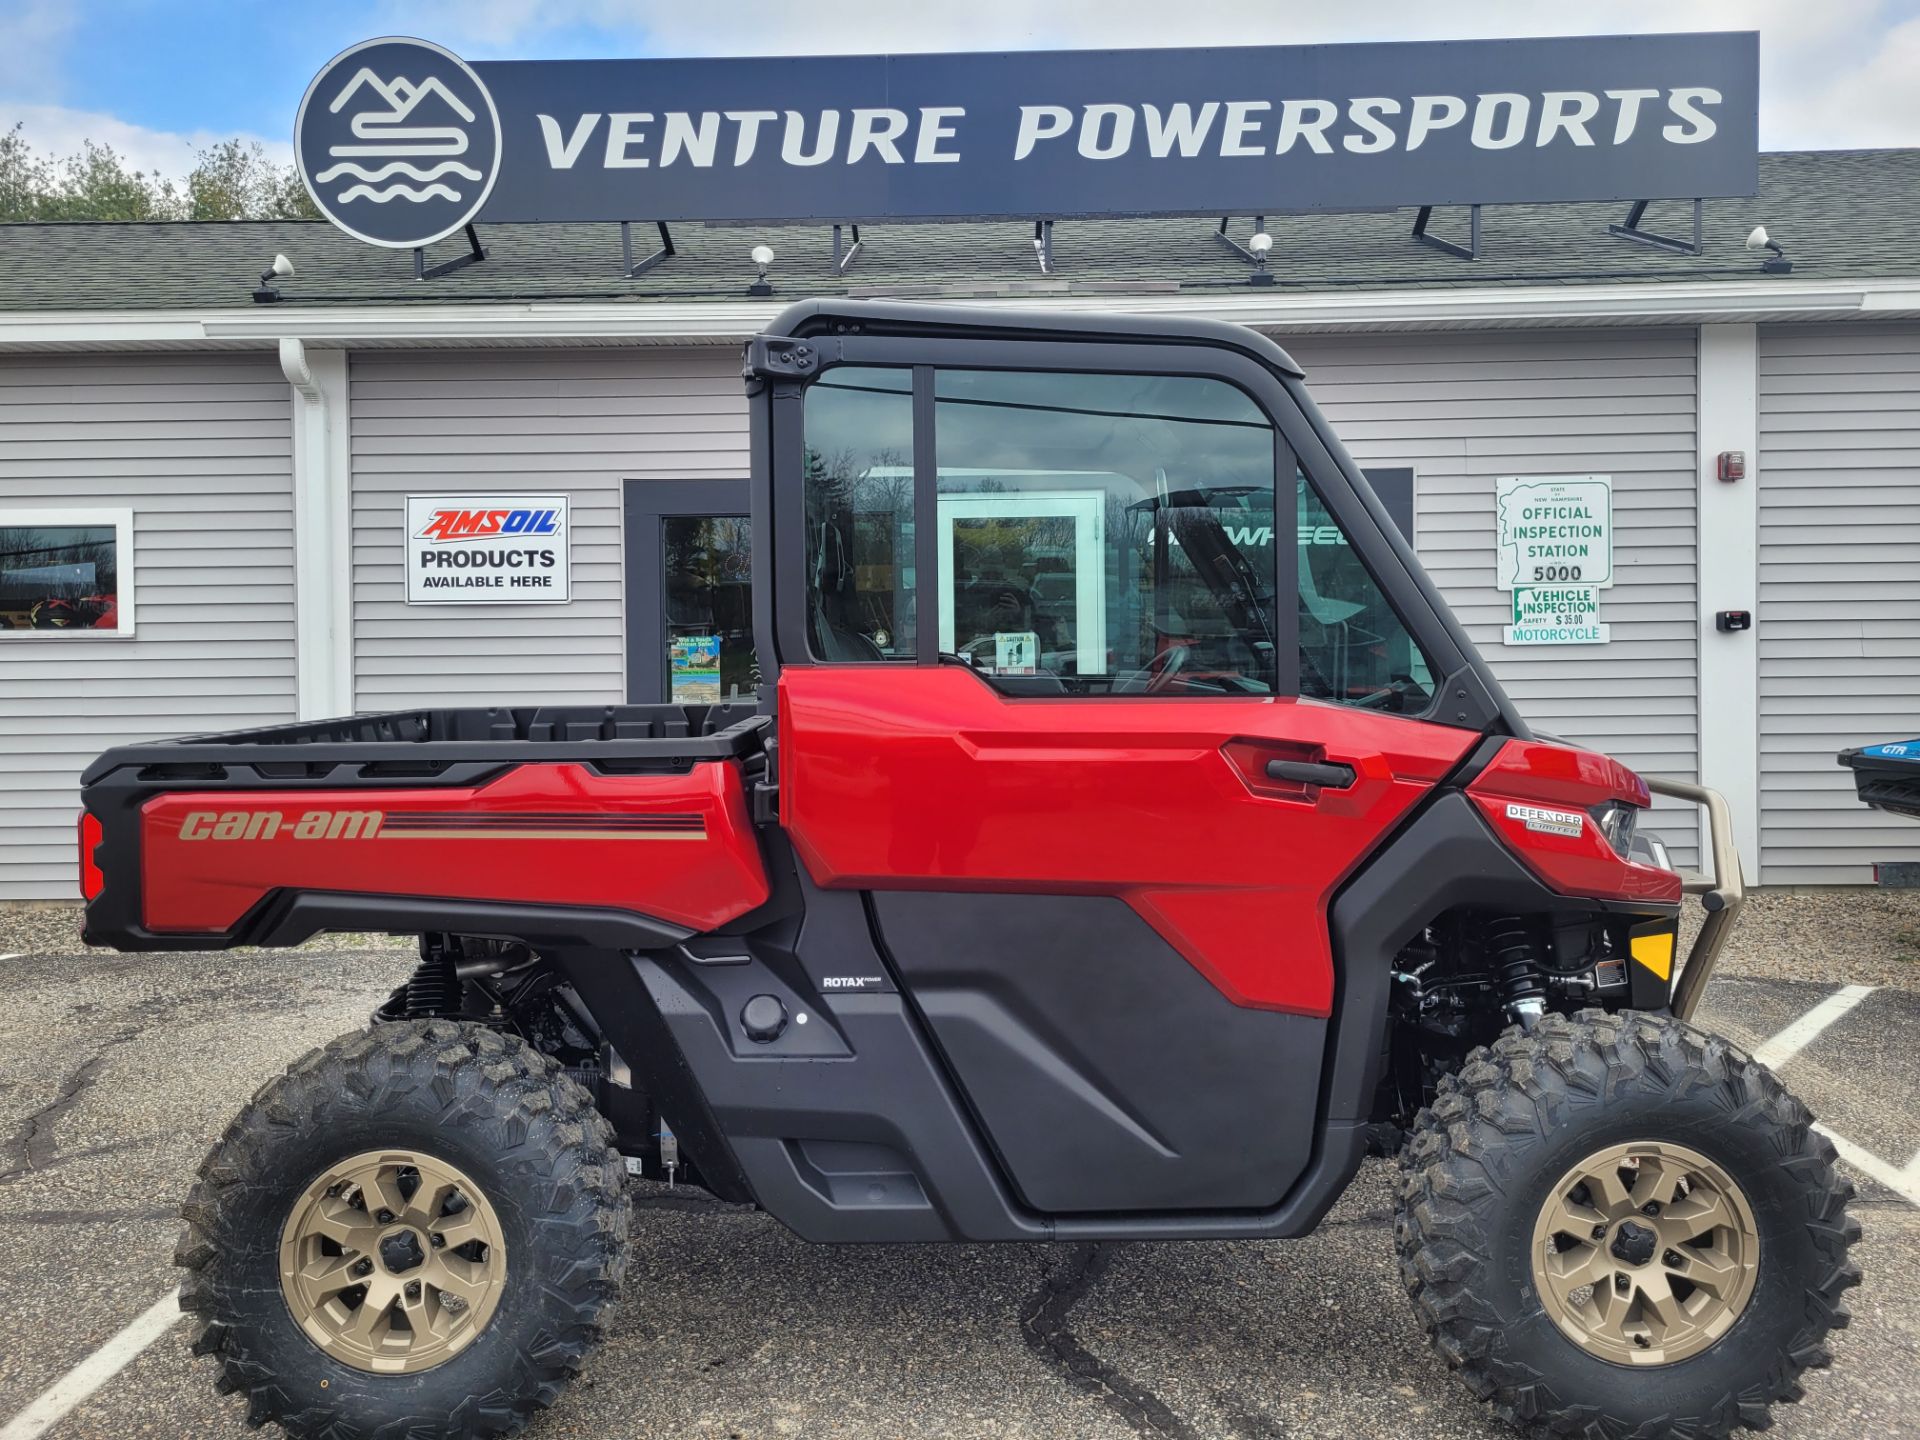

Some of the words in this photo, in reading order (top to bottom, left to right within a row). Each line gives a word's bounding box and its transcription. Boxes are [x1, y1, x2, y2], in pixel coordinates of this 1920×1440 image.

[535, 107, 966, 169] VENTURE
[1013, 87, 1723, 161] POWERSPORTS
[1522, 507, 1593, 520] OFFICIAL
[422, 510, 556, 540] AMSOIL
[1513, 525, 1602, 539] INSPECTION
[1528, 545, 1588, 558] STATION
[421, 549, 555, 568] PRODUCTS
[1534, 566, 1582, 581] 5000
[423, 576, 504, 588] AVAILABLE
[510, 576, 552, 587] HERE
[1531, 590, 1591, 602] VEHICLE
[1523, 602, 1596, 614] INSPECTION
[1555, 615, 1562, 625] $
[1564, 614, 1583, 625] 35.00
[1513, 626, 1600, 641] MOTORCYCLE
[1881, 745, 1908, 755] GTR
[1509, 806, 1581, 826] DEFENDER
[178, 810, 384, 841] can-am
[823, 977, 864, 987] ROTAX
